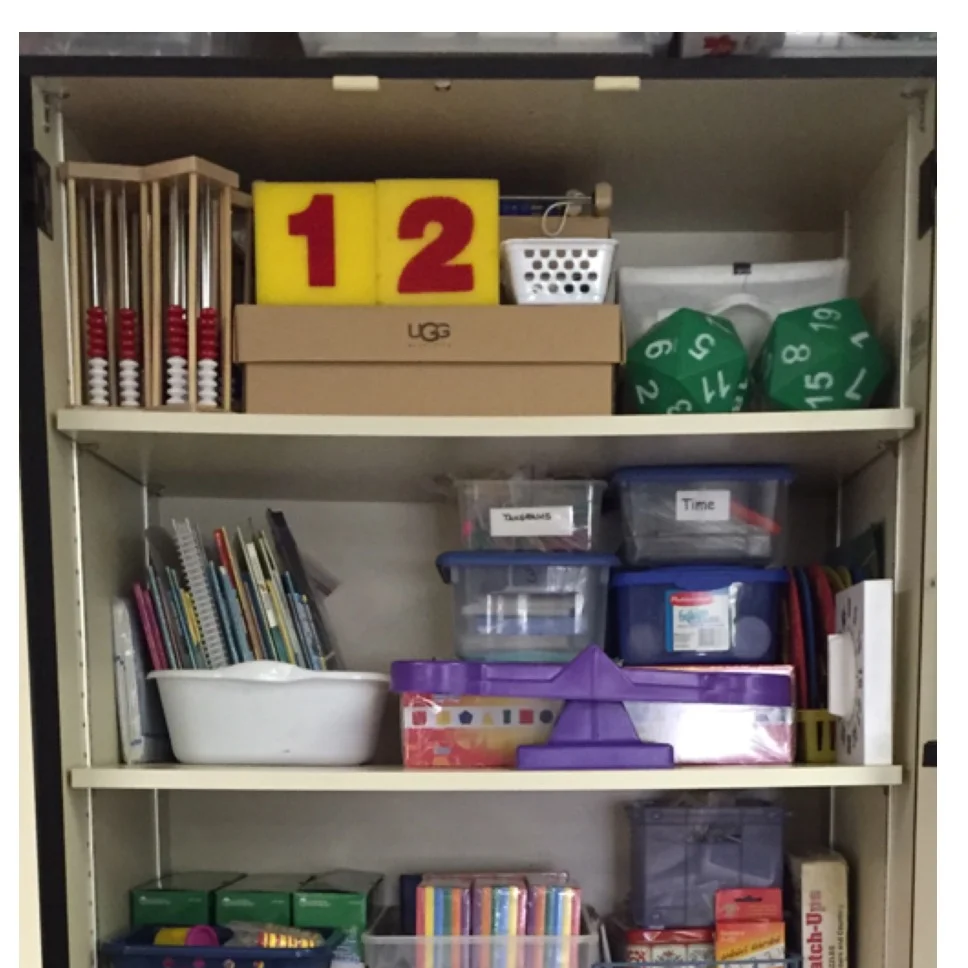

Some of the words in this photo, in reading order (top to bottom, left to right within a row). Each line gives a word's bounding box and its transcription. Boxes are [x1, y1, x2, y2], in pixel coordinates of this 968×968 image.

[287, 194, 335, 287] 1
[397, 195, 476, 294] 2
[408, 321, 451, 343] UGG
[781, 343, 812, 364] 8
[683, 498, 716, 511] Time
